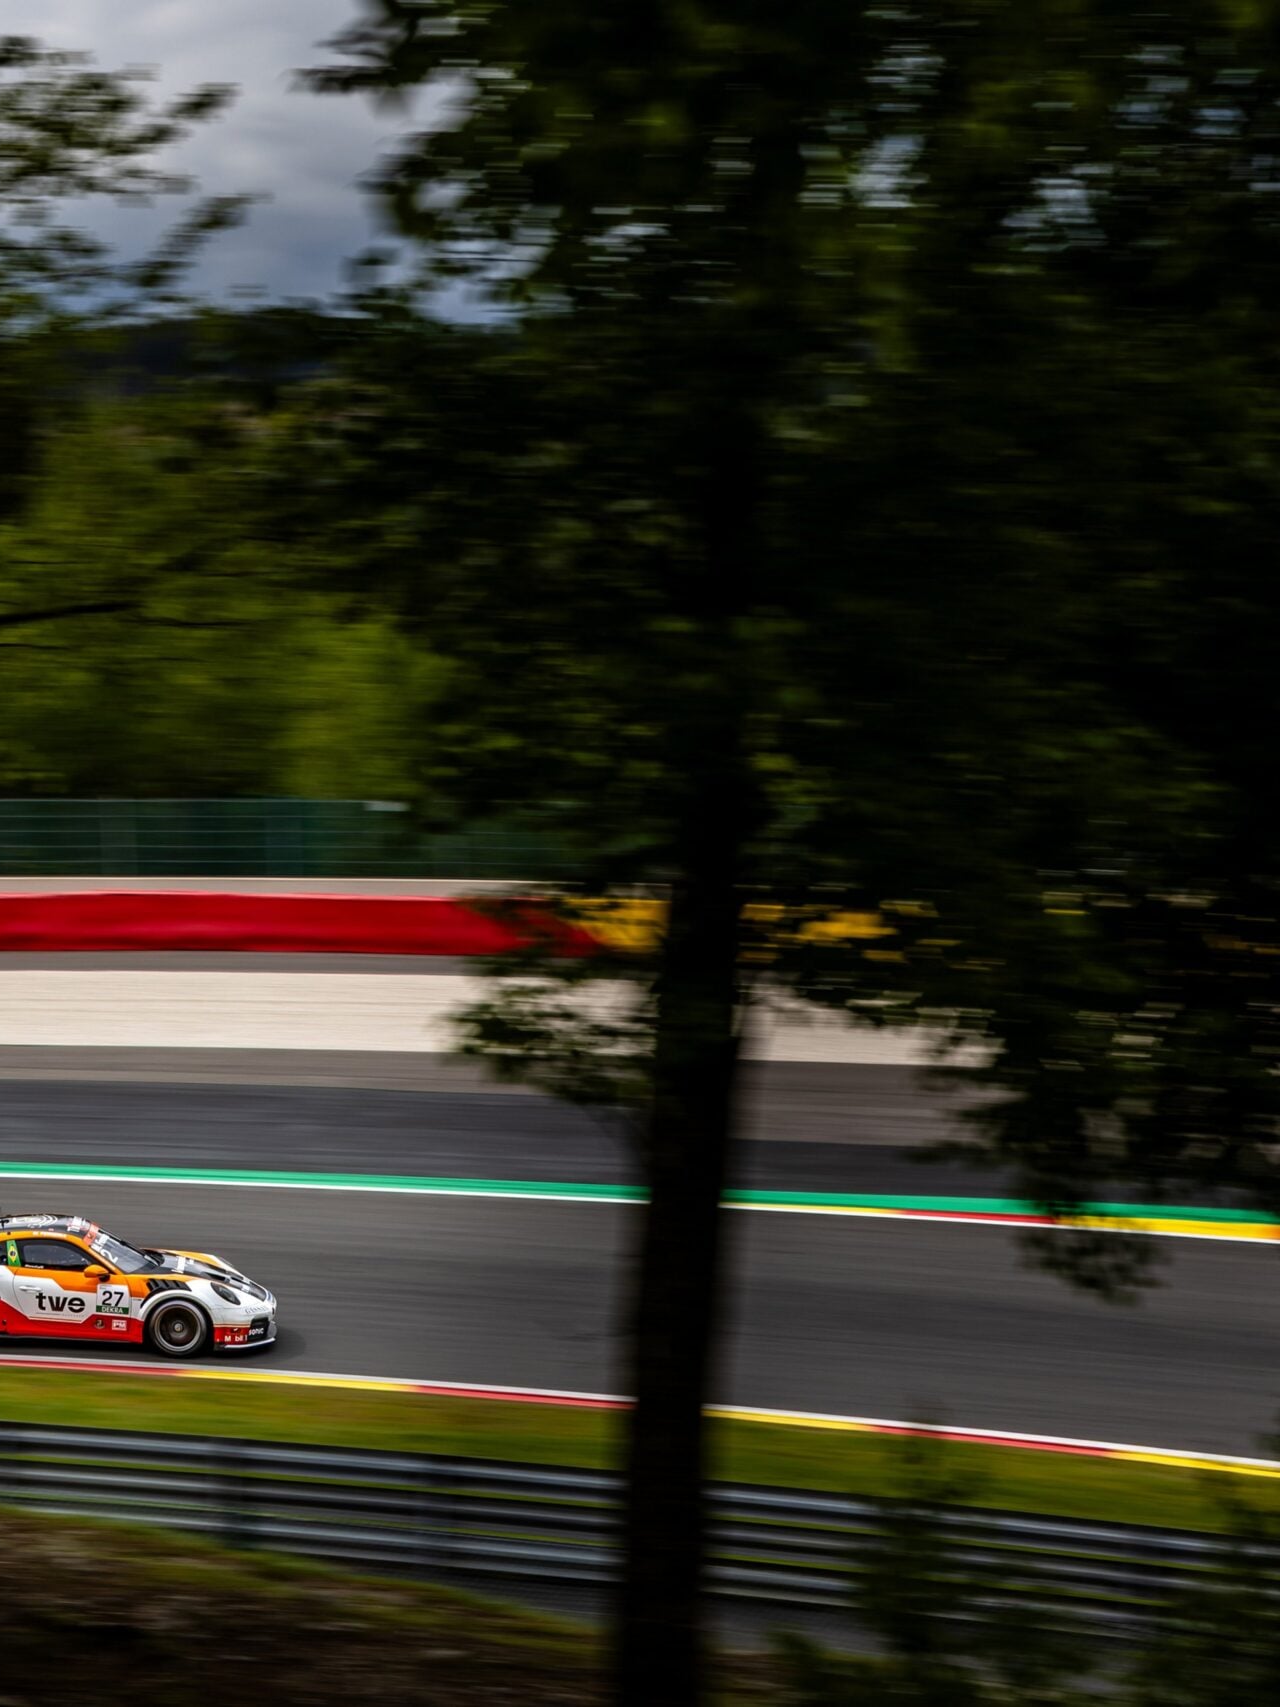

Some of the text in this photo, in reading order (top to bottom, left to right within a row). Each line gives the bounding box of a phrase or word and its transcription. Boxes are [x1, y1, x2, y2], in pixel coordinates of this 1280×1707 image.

[35, 1292, 86, 1314] twe
[102, 1290, 124, 1307] 27
[101, 1306, 124, 1314] DEKRA
